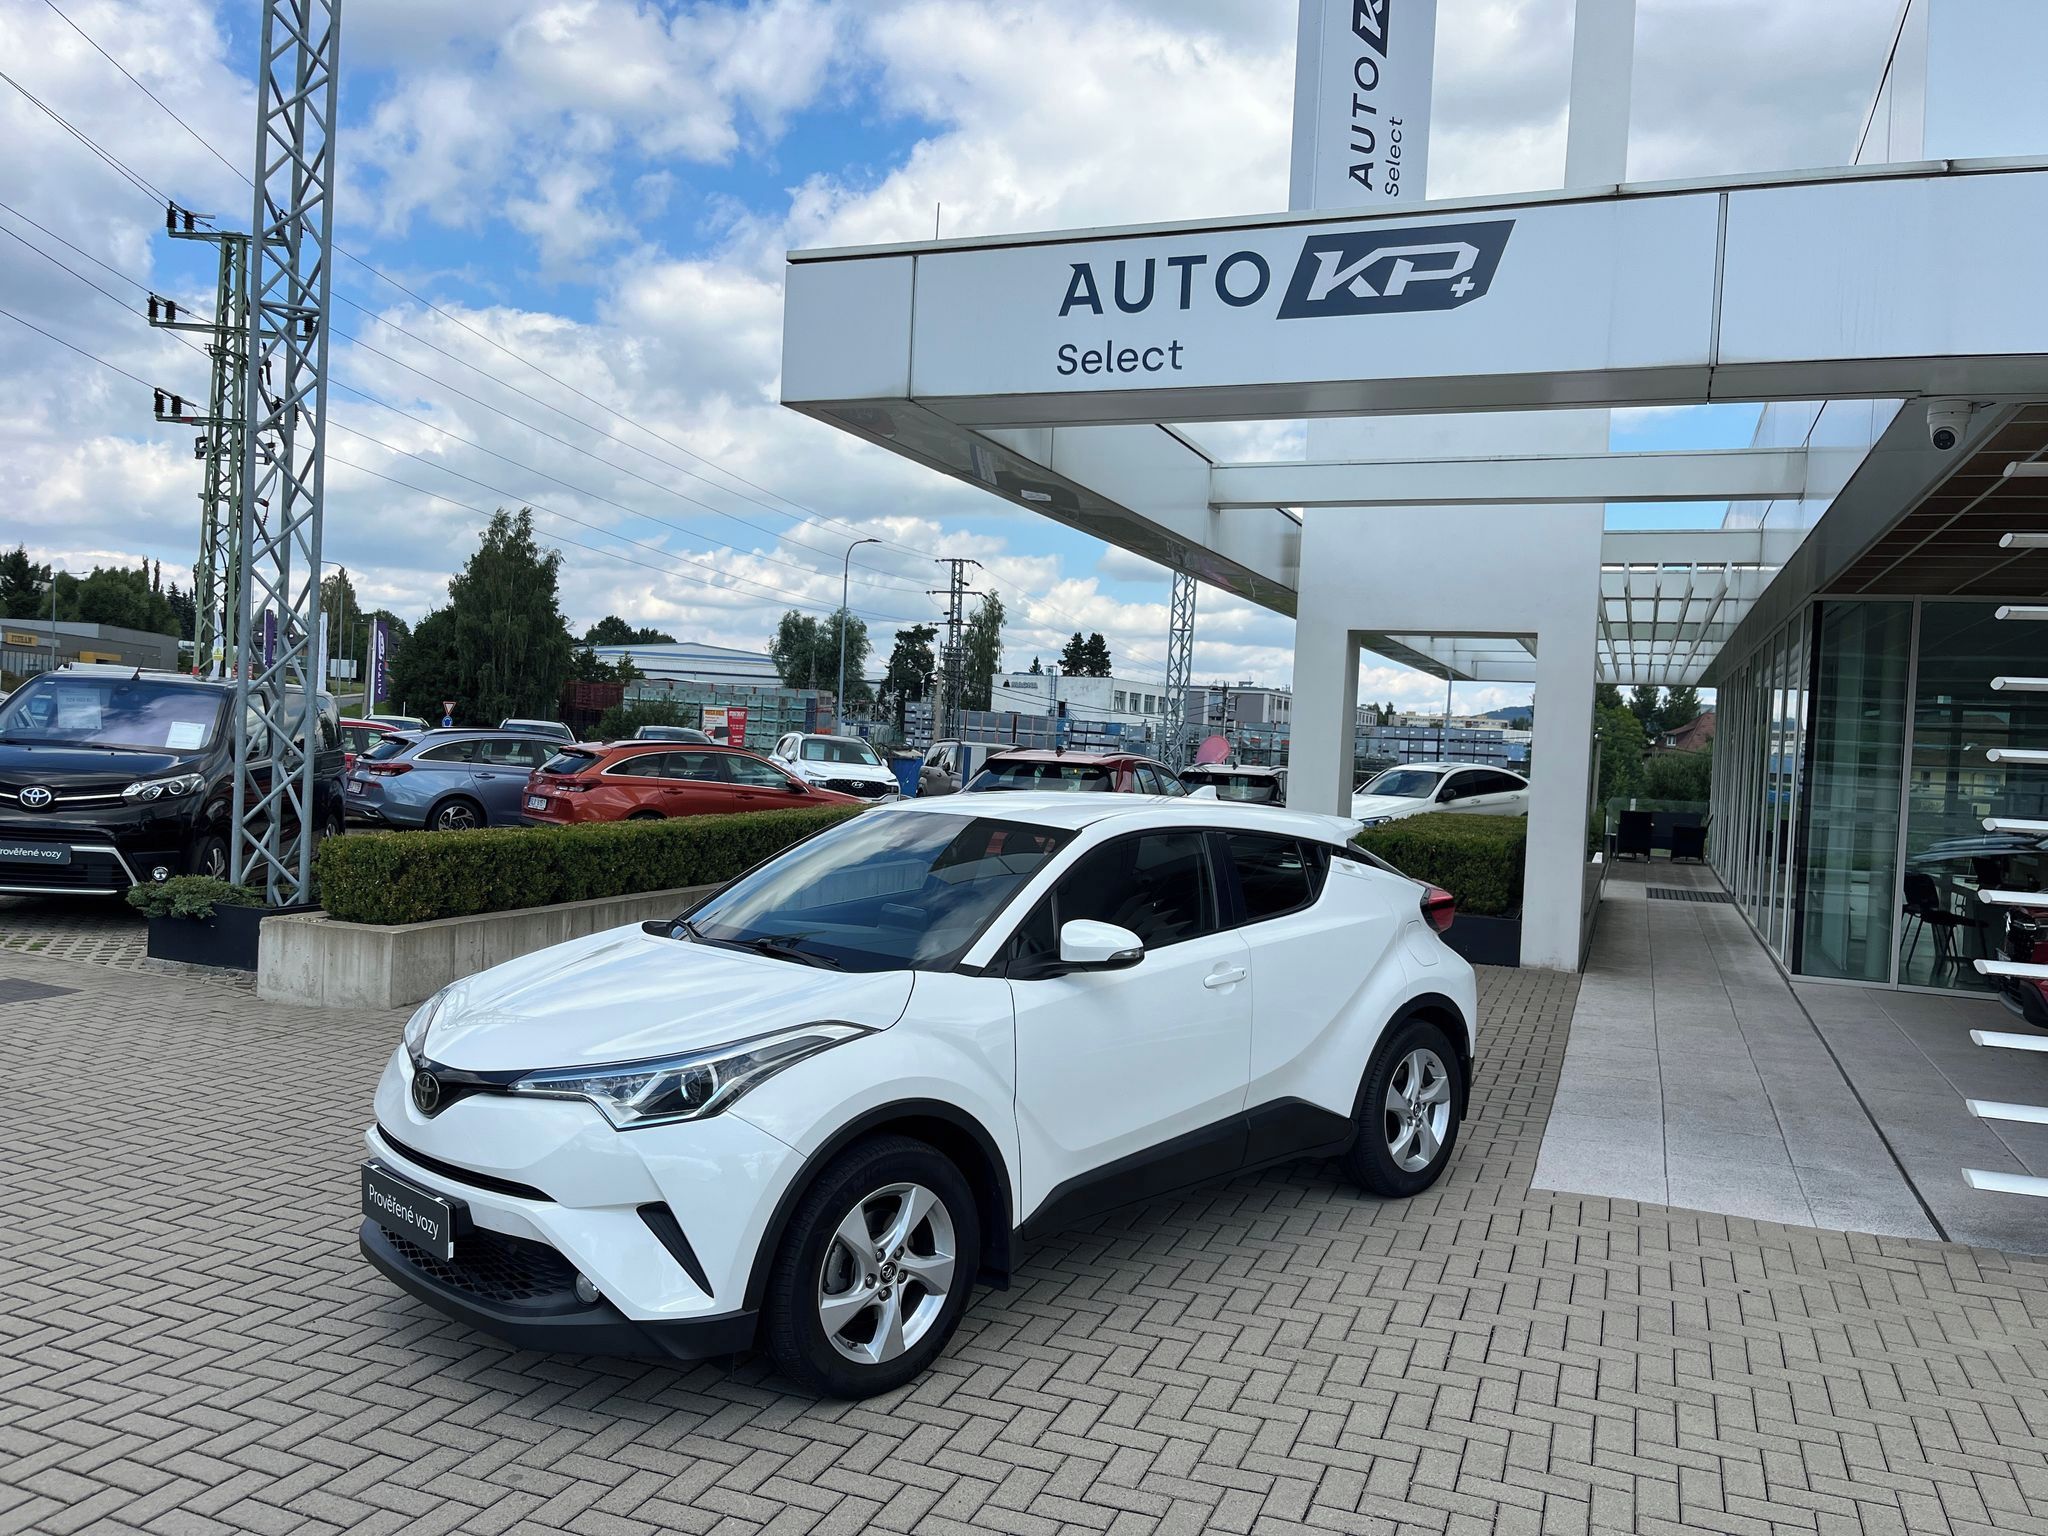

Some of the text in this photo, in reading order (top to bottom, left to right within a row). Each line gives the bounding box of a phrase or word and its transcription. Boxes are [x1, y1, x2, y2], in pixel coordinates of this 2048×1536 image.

[1349, 57, 1380, 191] AUTO
[1384, 116, 1402, 197] Select
[1058, 250, 1270, 317] AUTO
[1056, 339, 1184, 376] Select
[0, 847, 62, 861] rověřené vozy
[368, 1183, 440, 1241] Prověřené vozy
